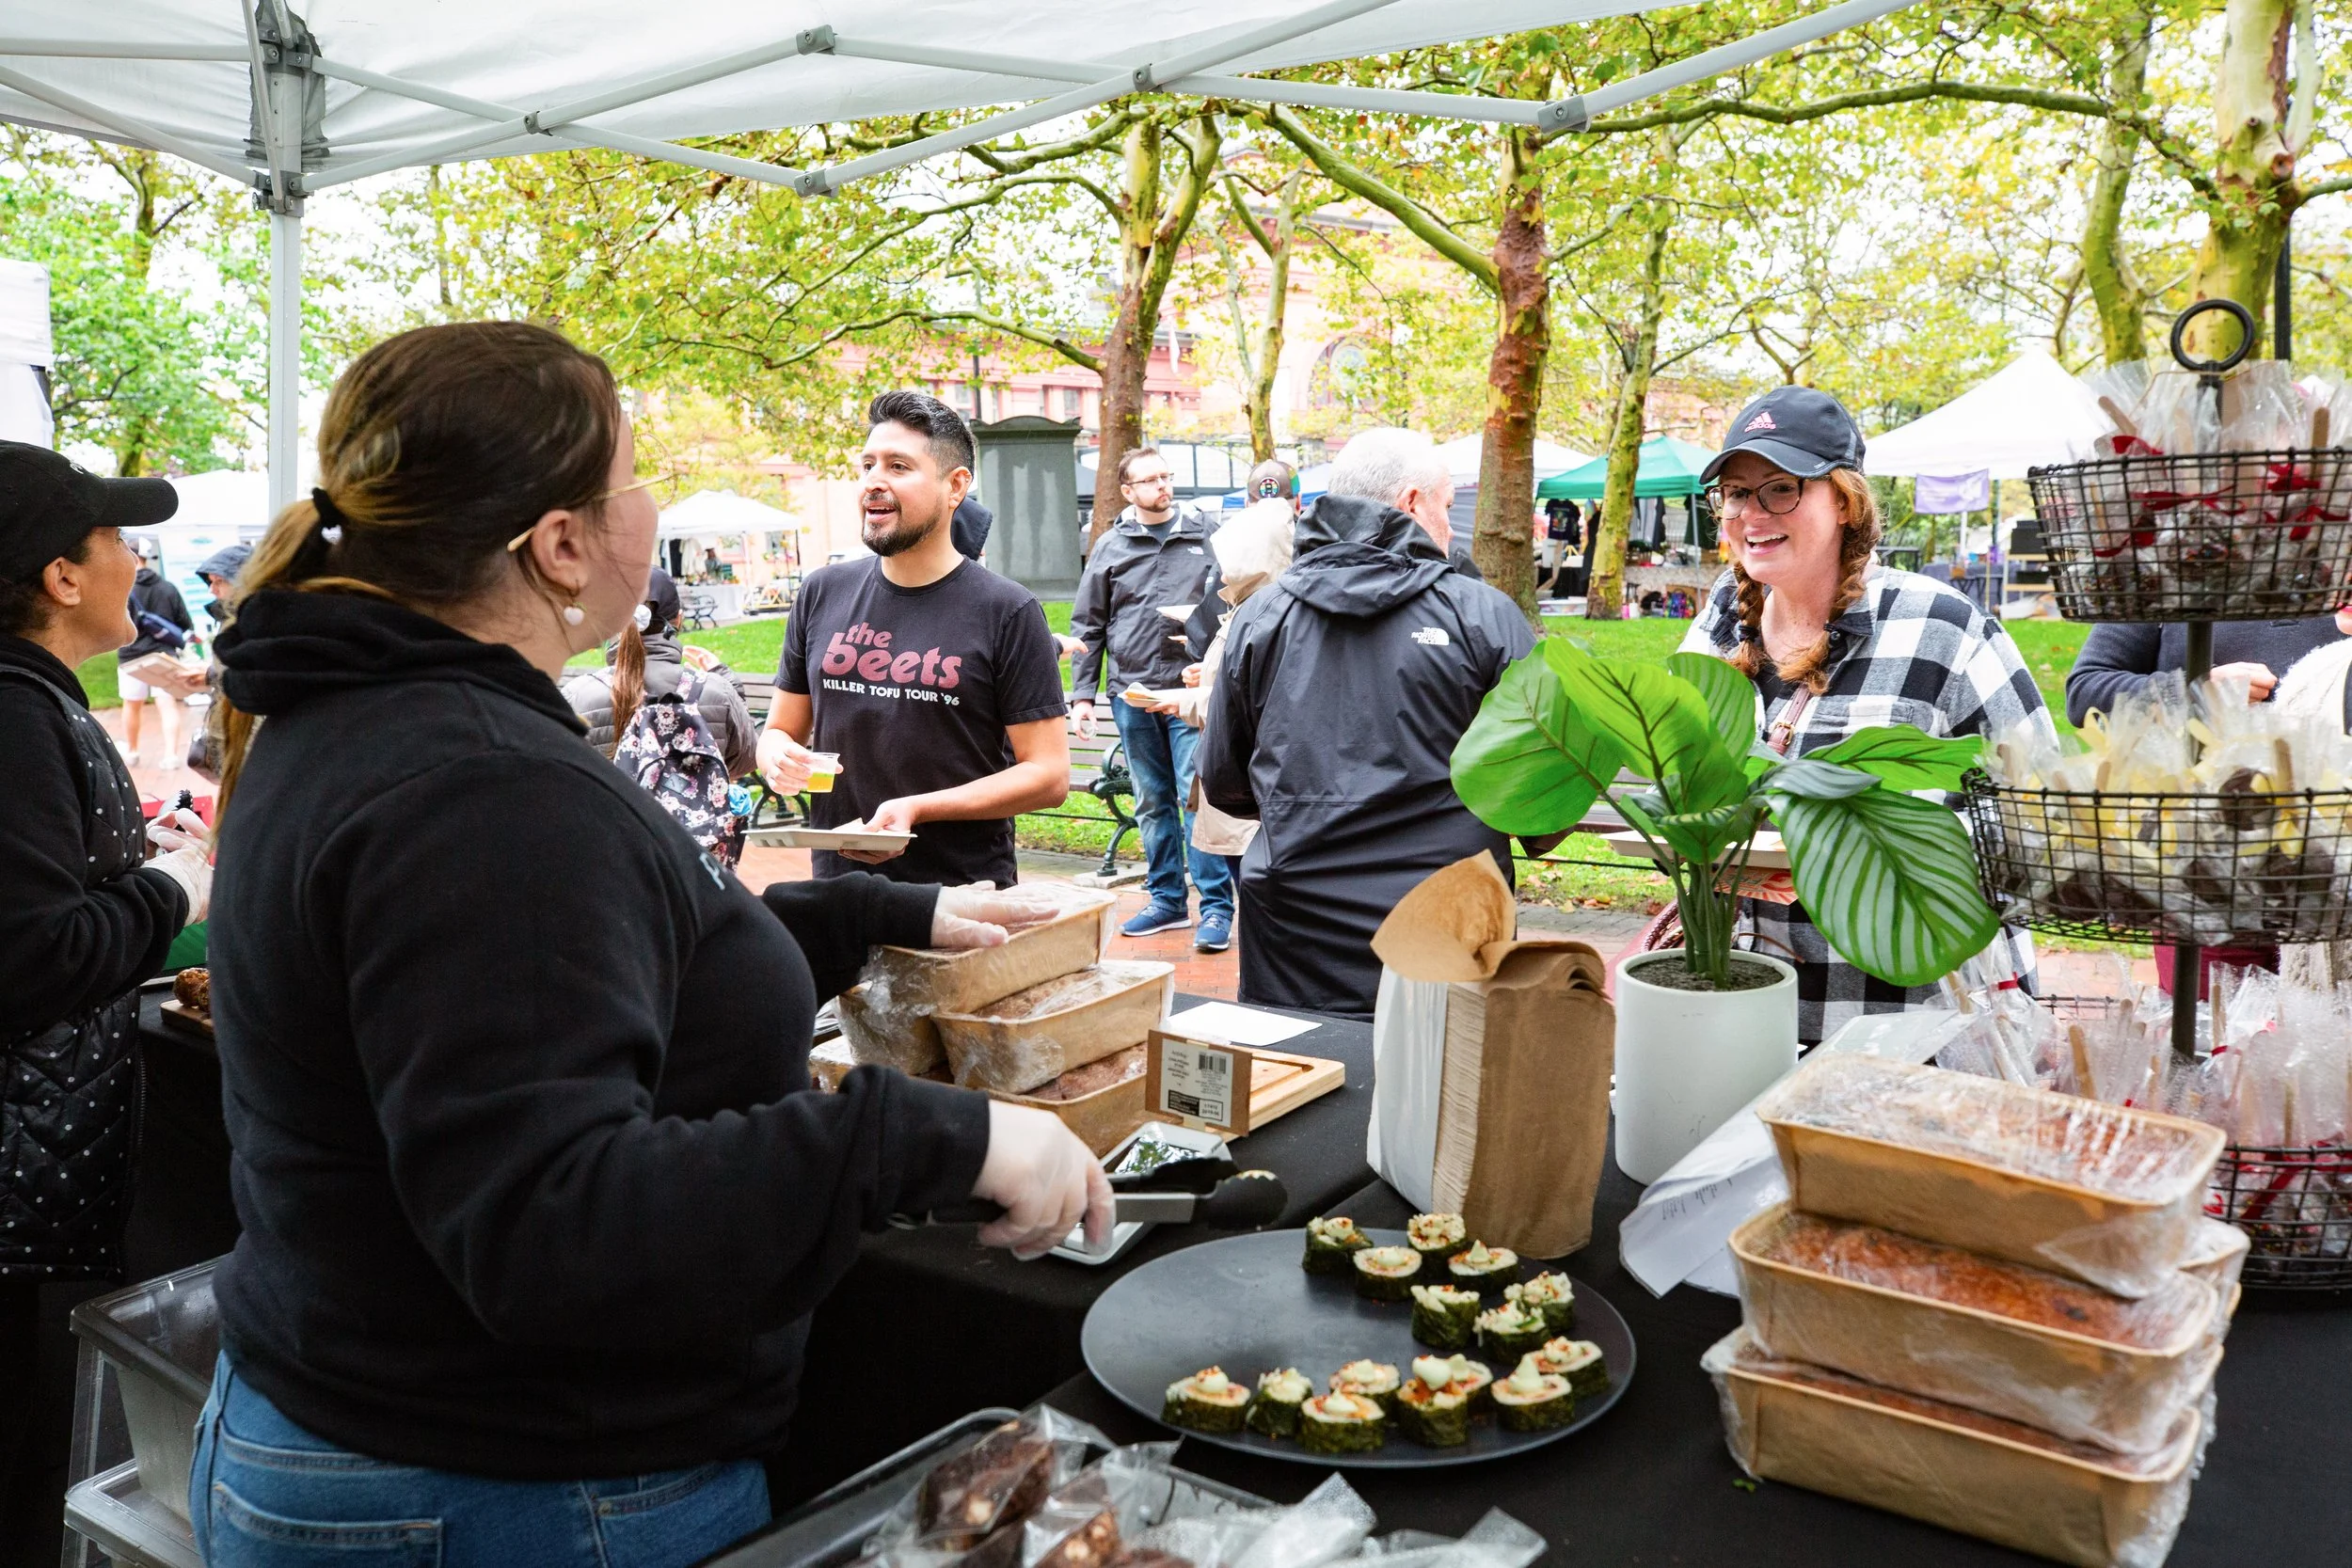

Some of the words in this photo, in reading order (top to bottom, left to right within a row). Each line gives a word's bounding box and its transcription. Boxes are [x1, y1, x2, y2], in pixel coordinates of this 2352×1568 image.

[846, 622, 892, 648] the
[822, 632, 961, 689] beets
[823, 679, 866, 694] KILLER
[869, 685, 900, 699] TOFU
[904, 689, 938, 703] TOUR
